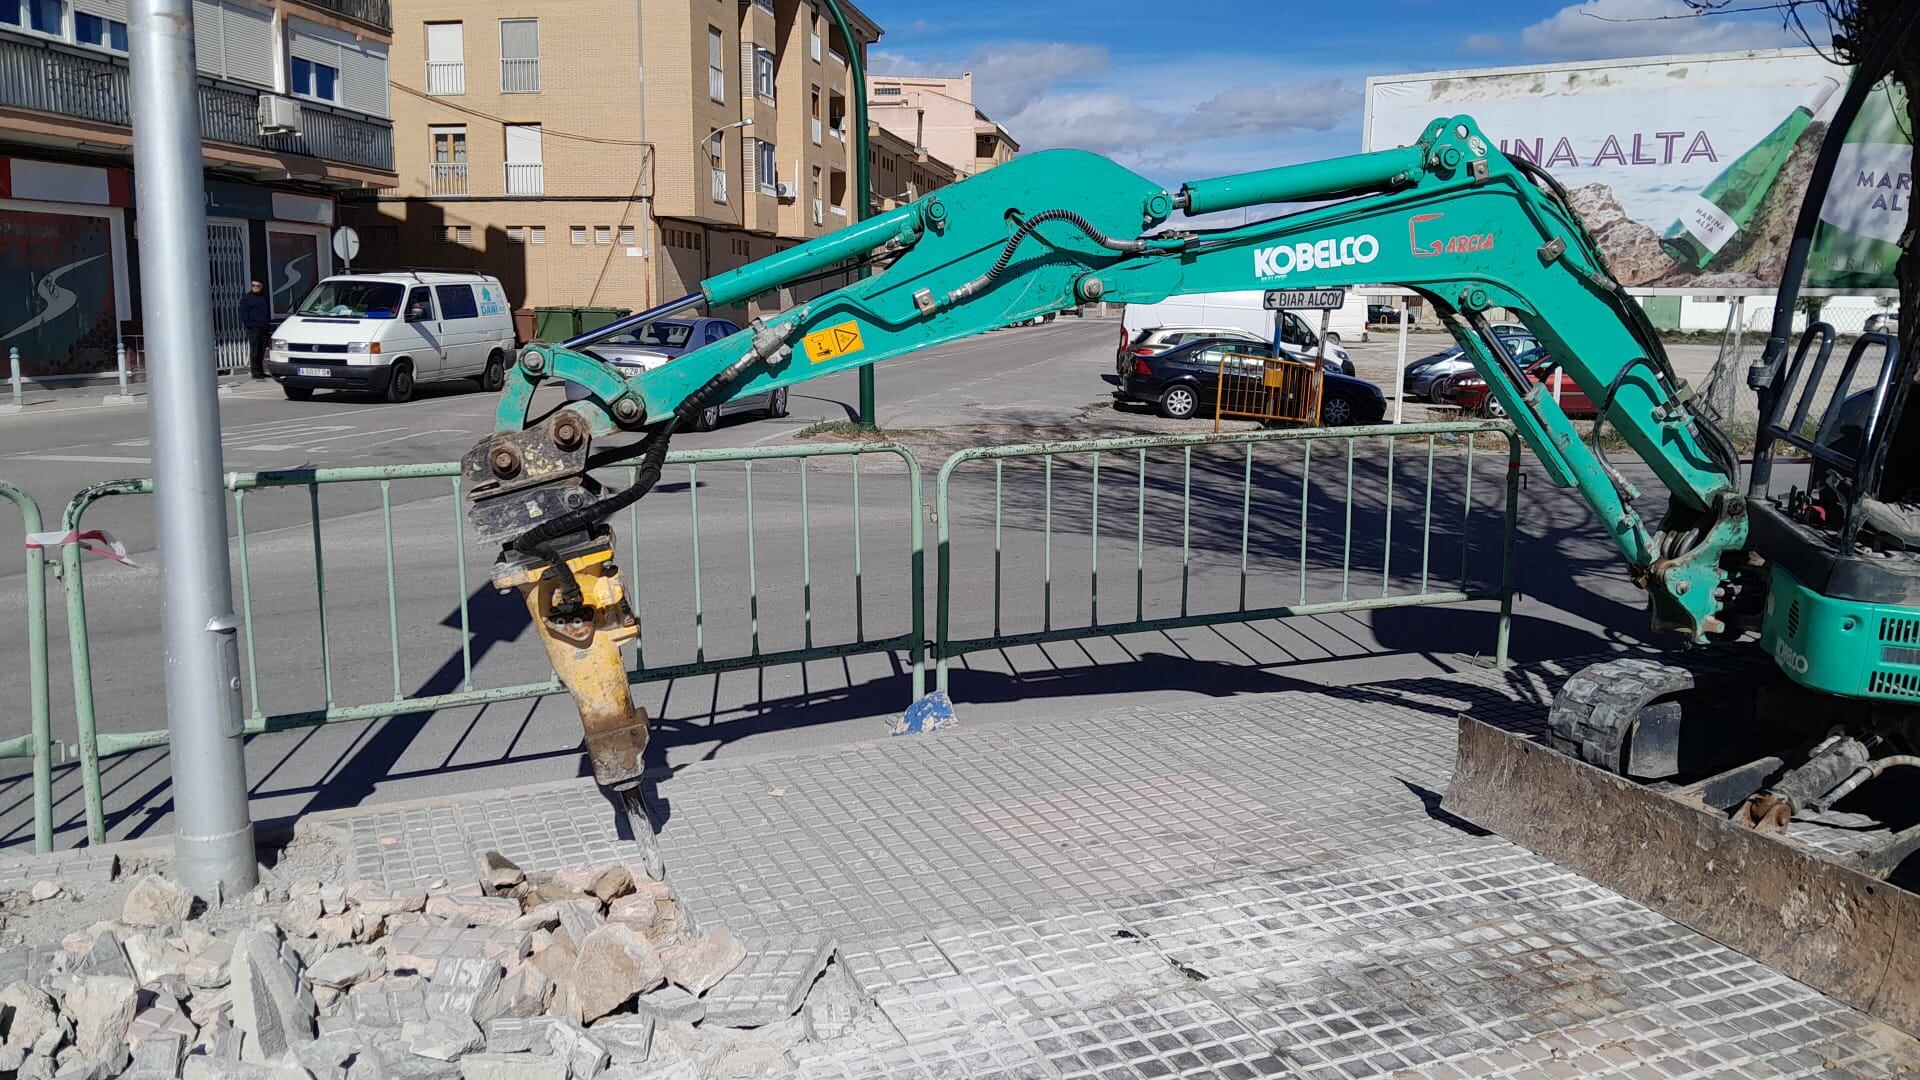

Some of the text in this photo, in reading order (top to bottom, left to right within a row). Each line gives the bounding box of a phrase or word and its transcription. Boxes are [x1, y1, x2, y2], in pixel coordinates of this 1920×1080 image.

[1592, 130, 1718, 166] ALTA
[1872, 193, 1910, 212] AL
[1695, 207, 1725, 231] MARINA
[1695, 217, 1714, 233] ALTA
[1253, 234, 1380, 278] KOBELCO
